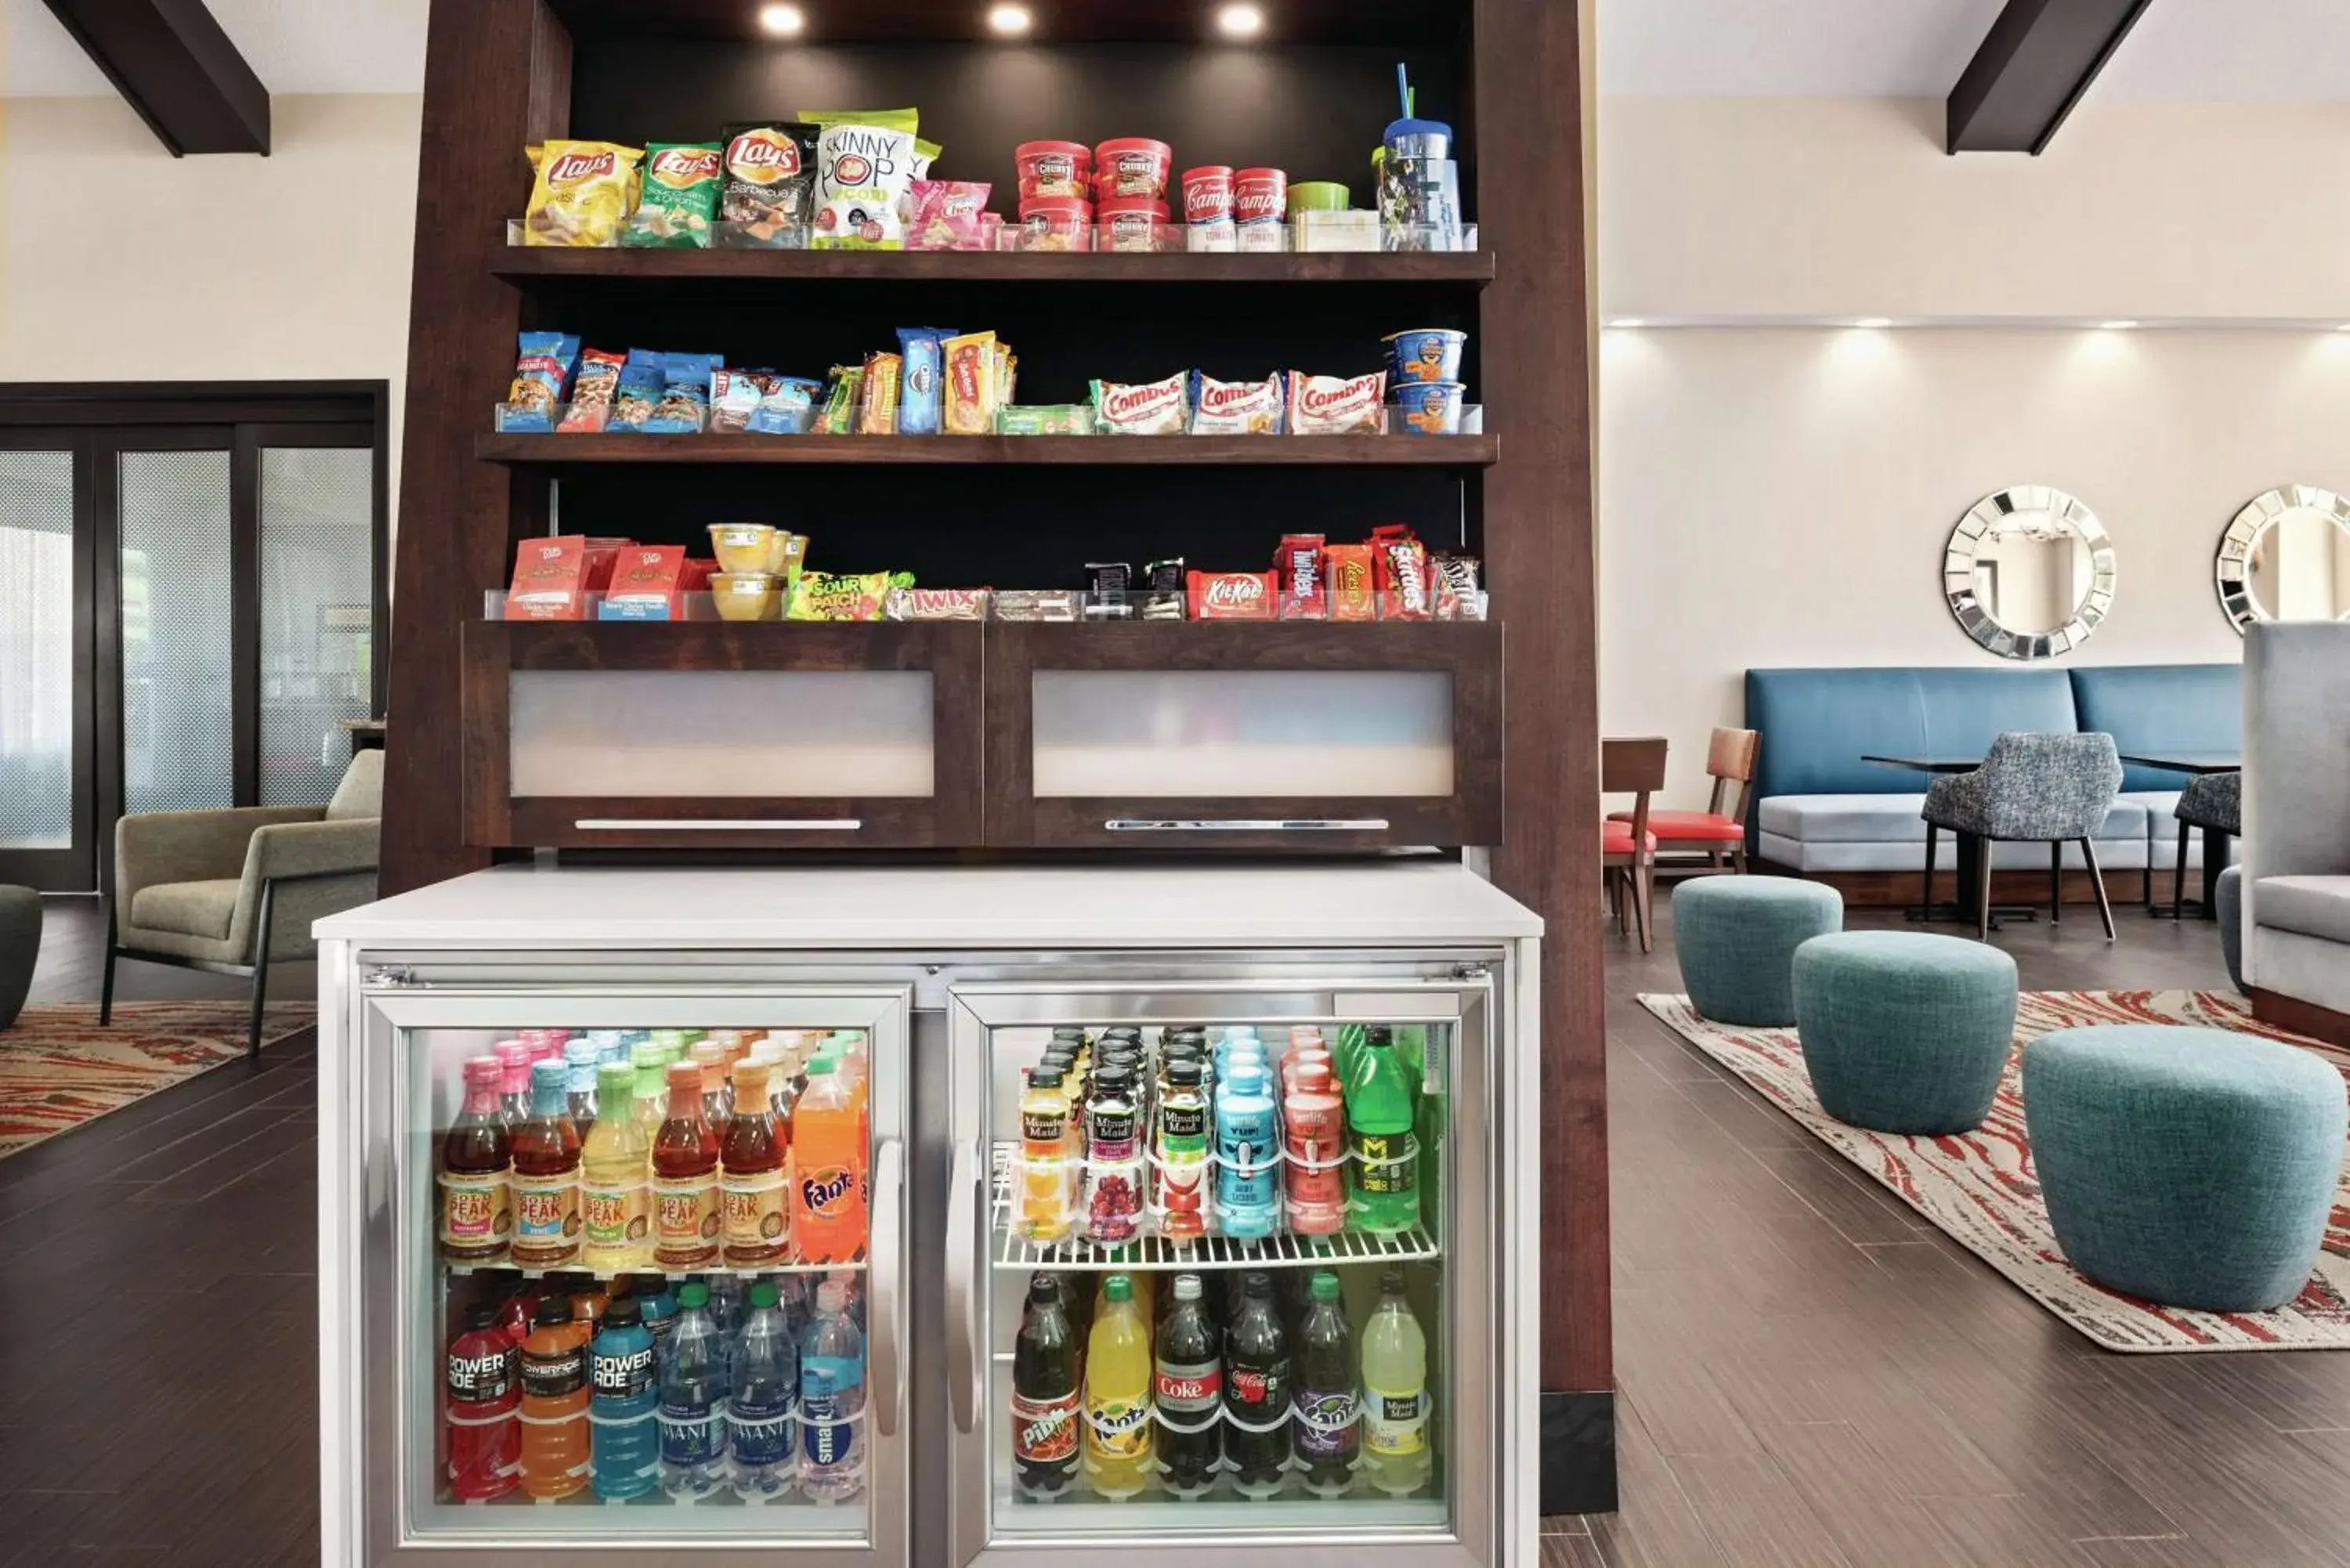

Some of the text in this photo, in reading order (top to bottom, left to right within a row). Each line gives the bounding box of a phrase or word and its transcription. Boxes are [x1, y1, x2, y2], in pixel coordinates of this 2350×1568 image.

[1305, 377, 1374, 410] Combos
[1388, 546, 1423, 610] Skittles
[812, 579, 861, 595] SOUR
[811, 592, 862, 609] PATCH
[912, 589, 974, 614] TWIX
[1025, 1115, 1063, 1128] Minute
[1096, 1115, 1132, 1127] Minute
[1165, 1110, 1201, 1122] Minute
[1029, 1126, 1057, 1137] Maid
[1100, 1125, 1128, 1136] Maid
[1169, 1121, 1196, 1132] Maid
[449, 1200, 493, 1216] PEAK
[519, 1202, 562, 1218] PEAK
[588, 1204, 624, 1221] PEAK
[660, 1203, 698, 1219] PEAK
[722, 1201, 758, 1216] PEAK
[449, 1353, 504, 1374] POWER
[594, 1349, 652, 1373] POWER
[594, 1371, 627, 1388] ADE
[1160, 1377, 1202, 1398] Coke
